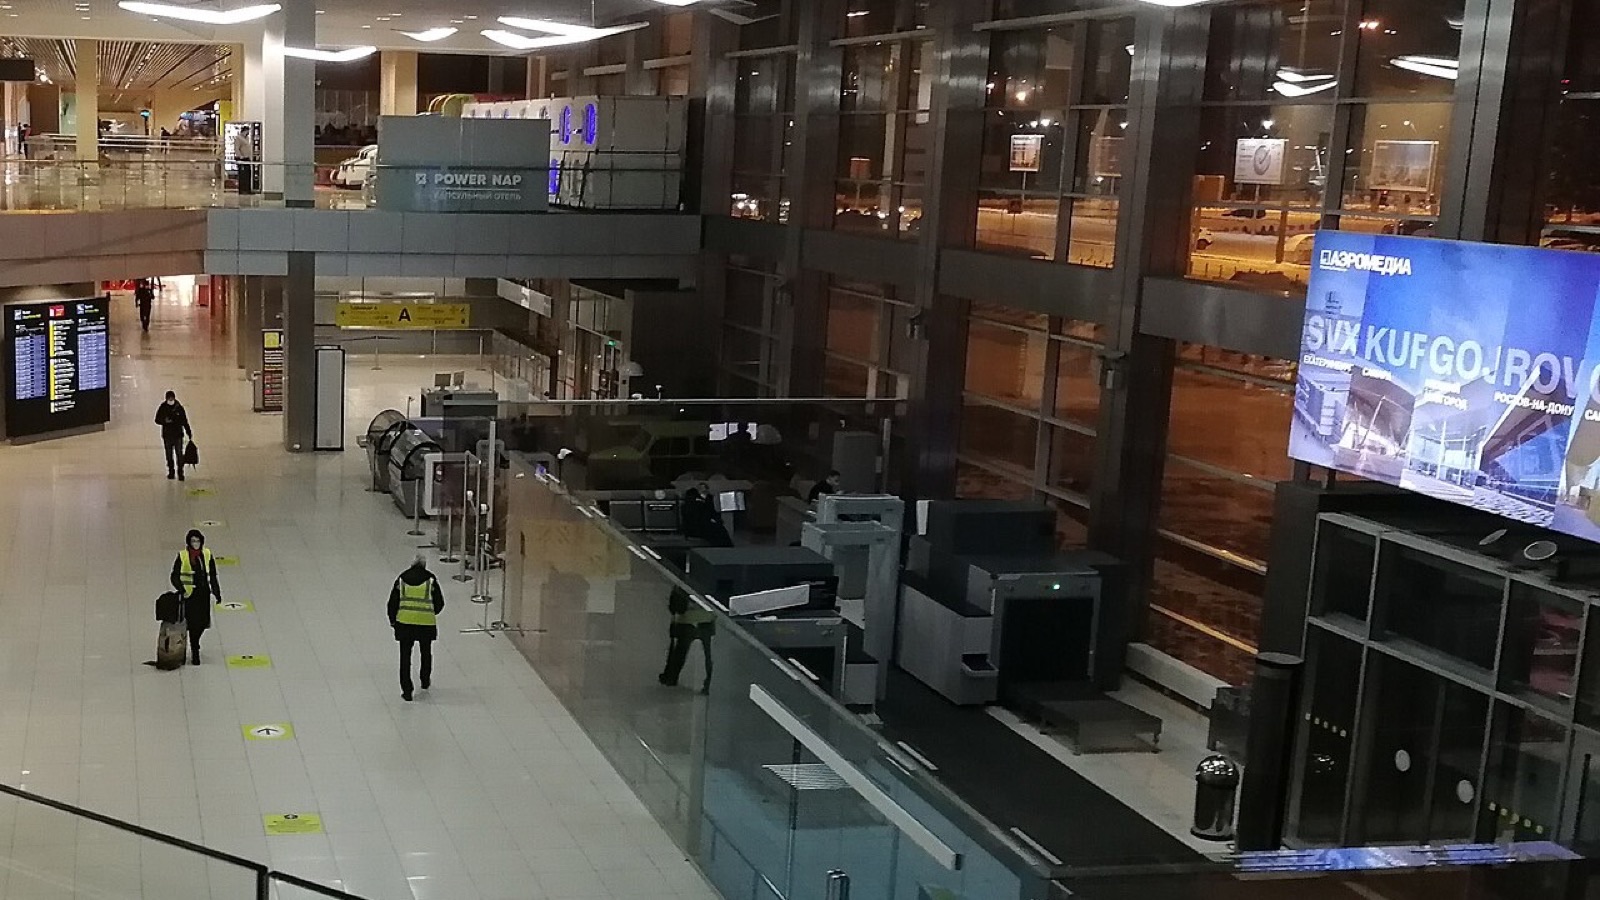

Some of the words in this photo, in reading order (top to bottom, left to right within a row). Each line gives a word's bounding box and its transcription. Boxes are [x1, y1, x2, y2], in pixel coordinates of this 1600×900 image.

[434, 173, 487, 185] POWER
[492, 174, 522, 186] NAP
[1331, 250, 1411, 276] АЭРОМЕДИА
[398, 307, 411, 322] A
[1308, 315, 1360, 356] SVX
[1365, 325, 1428, 369] KUF
[1504, 348, 1583, 398] ROV
